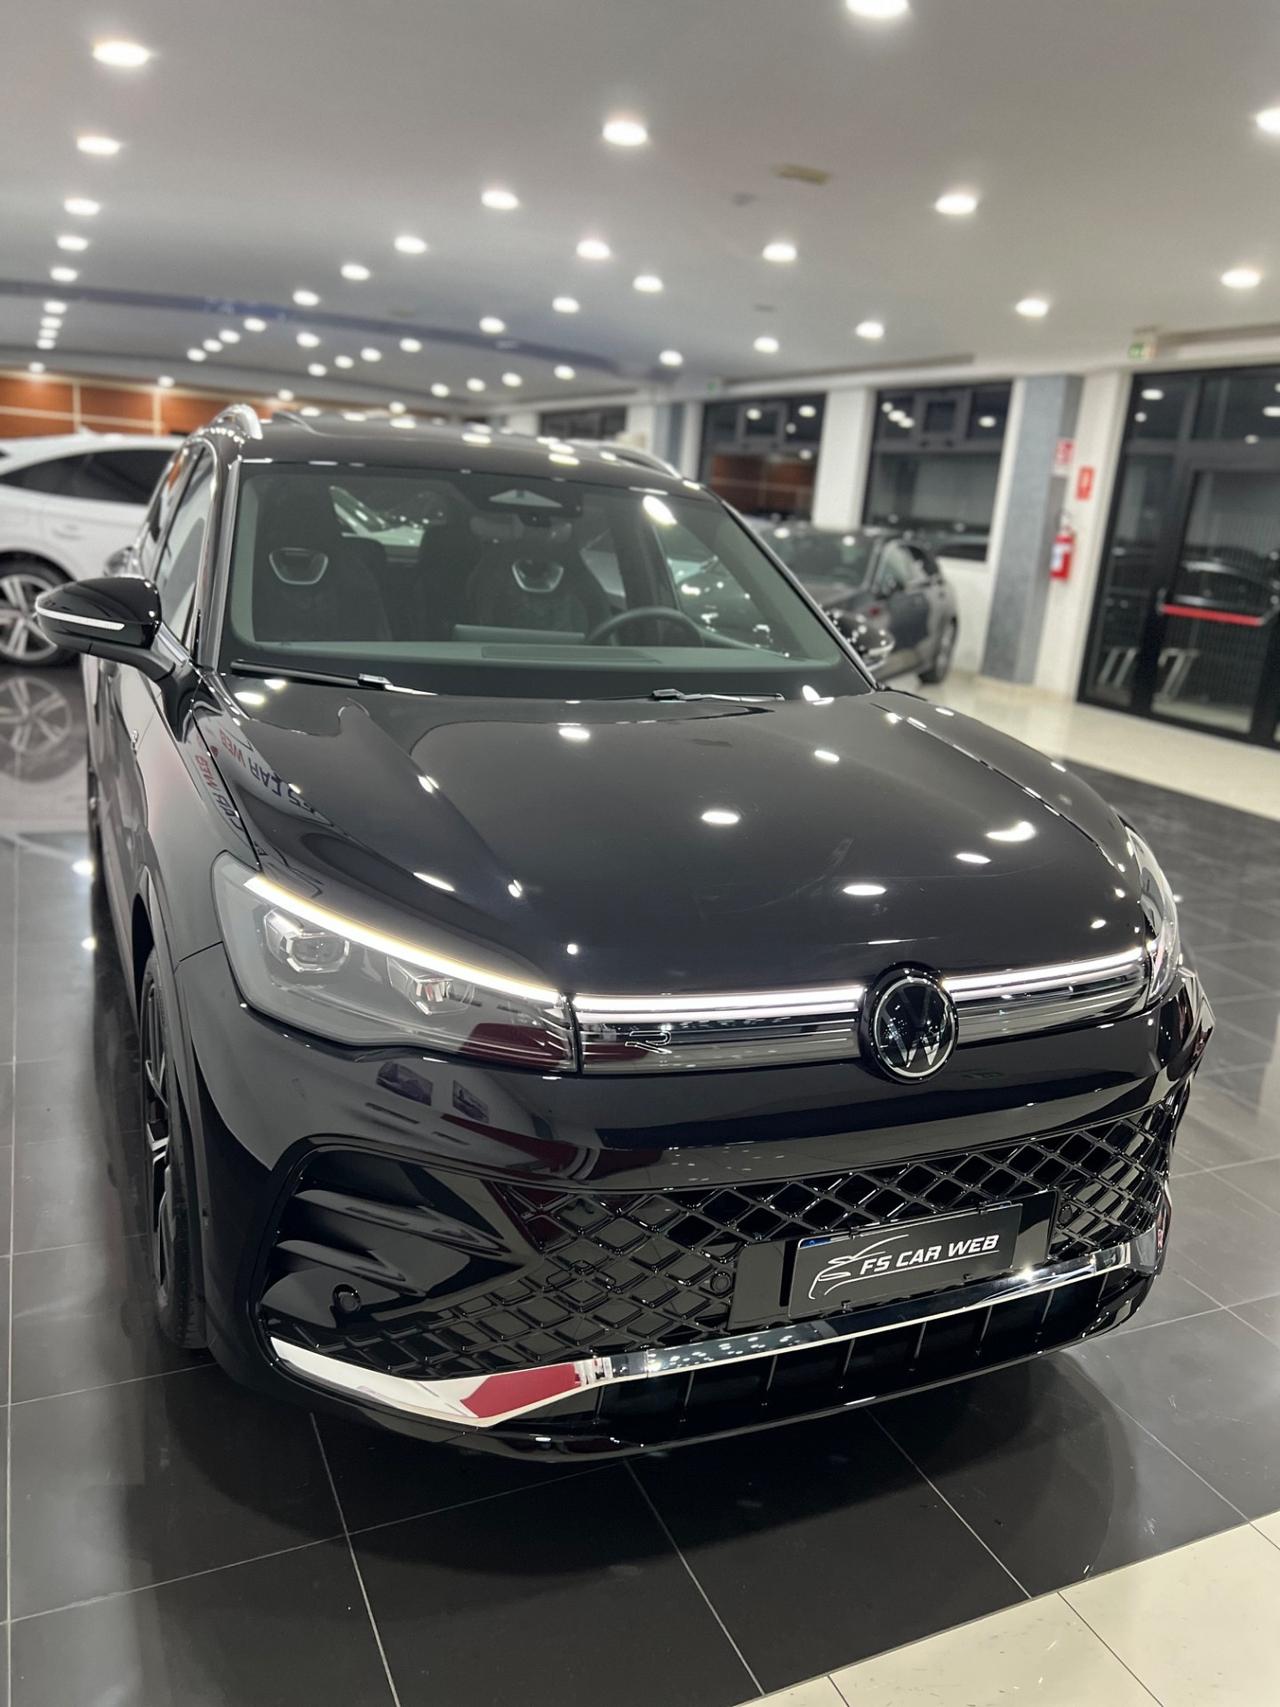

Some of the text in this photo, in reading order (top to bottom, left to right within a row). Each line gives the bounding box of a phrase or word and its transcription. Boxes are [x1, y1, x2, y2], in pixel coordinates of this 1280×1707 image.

[860, 1234, 1000, 1275] FS CAR WEB
